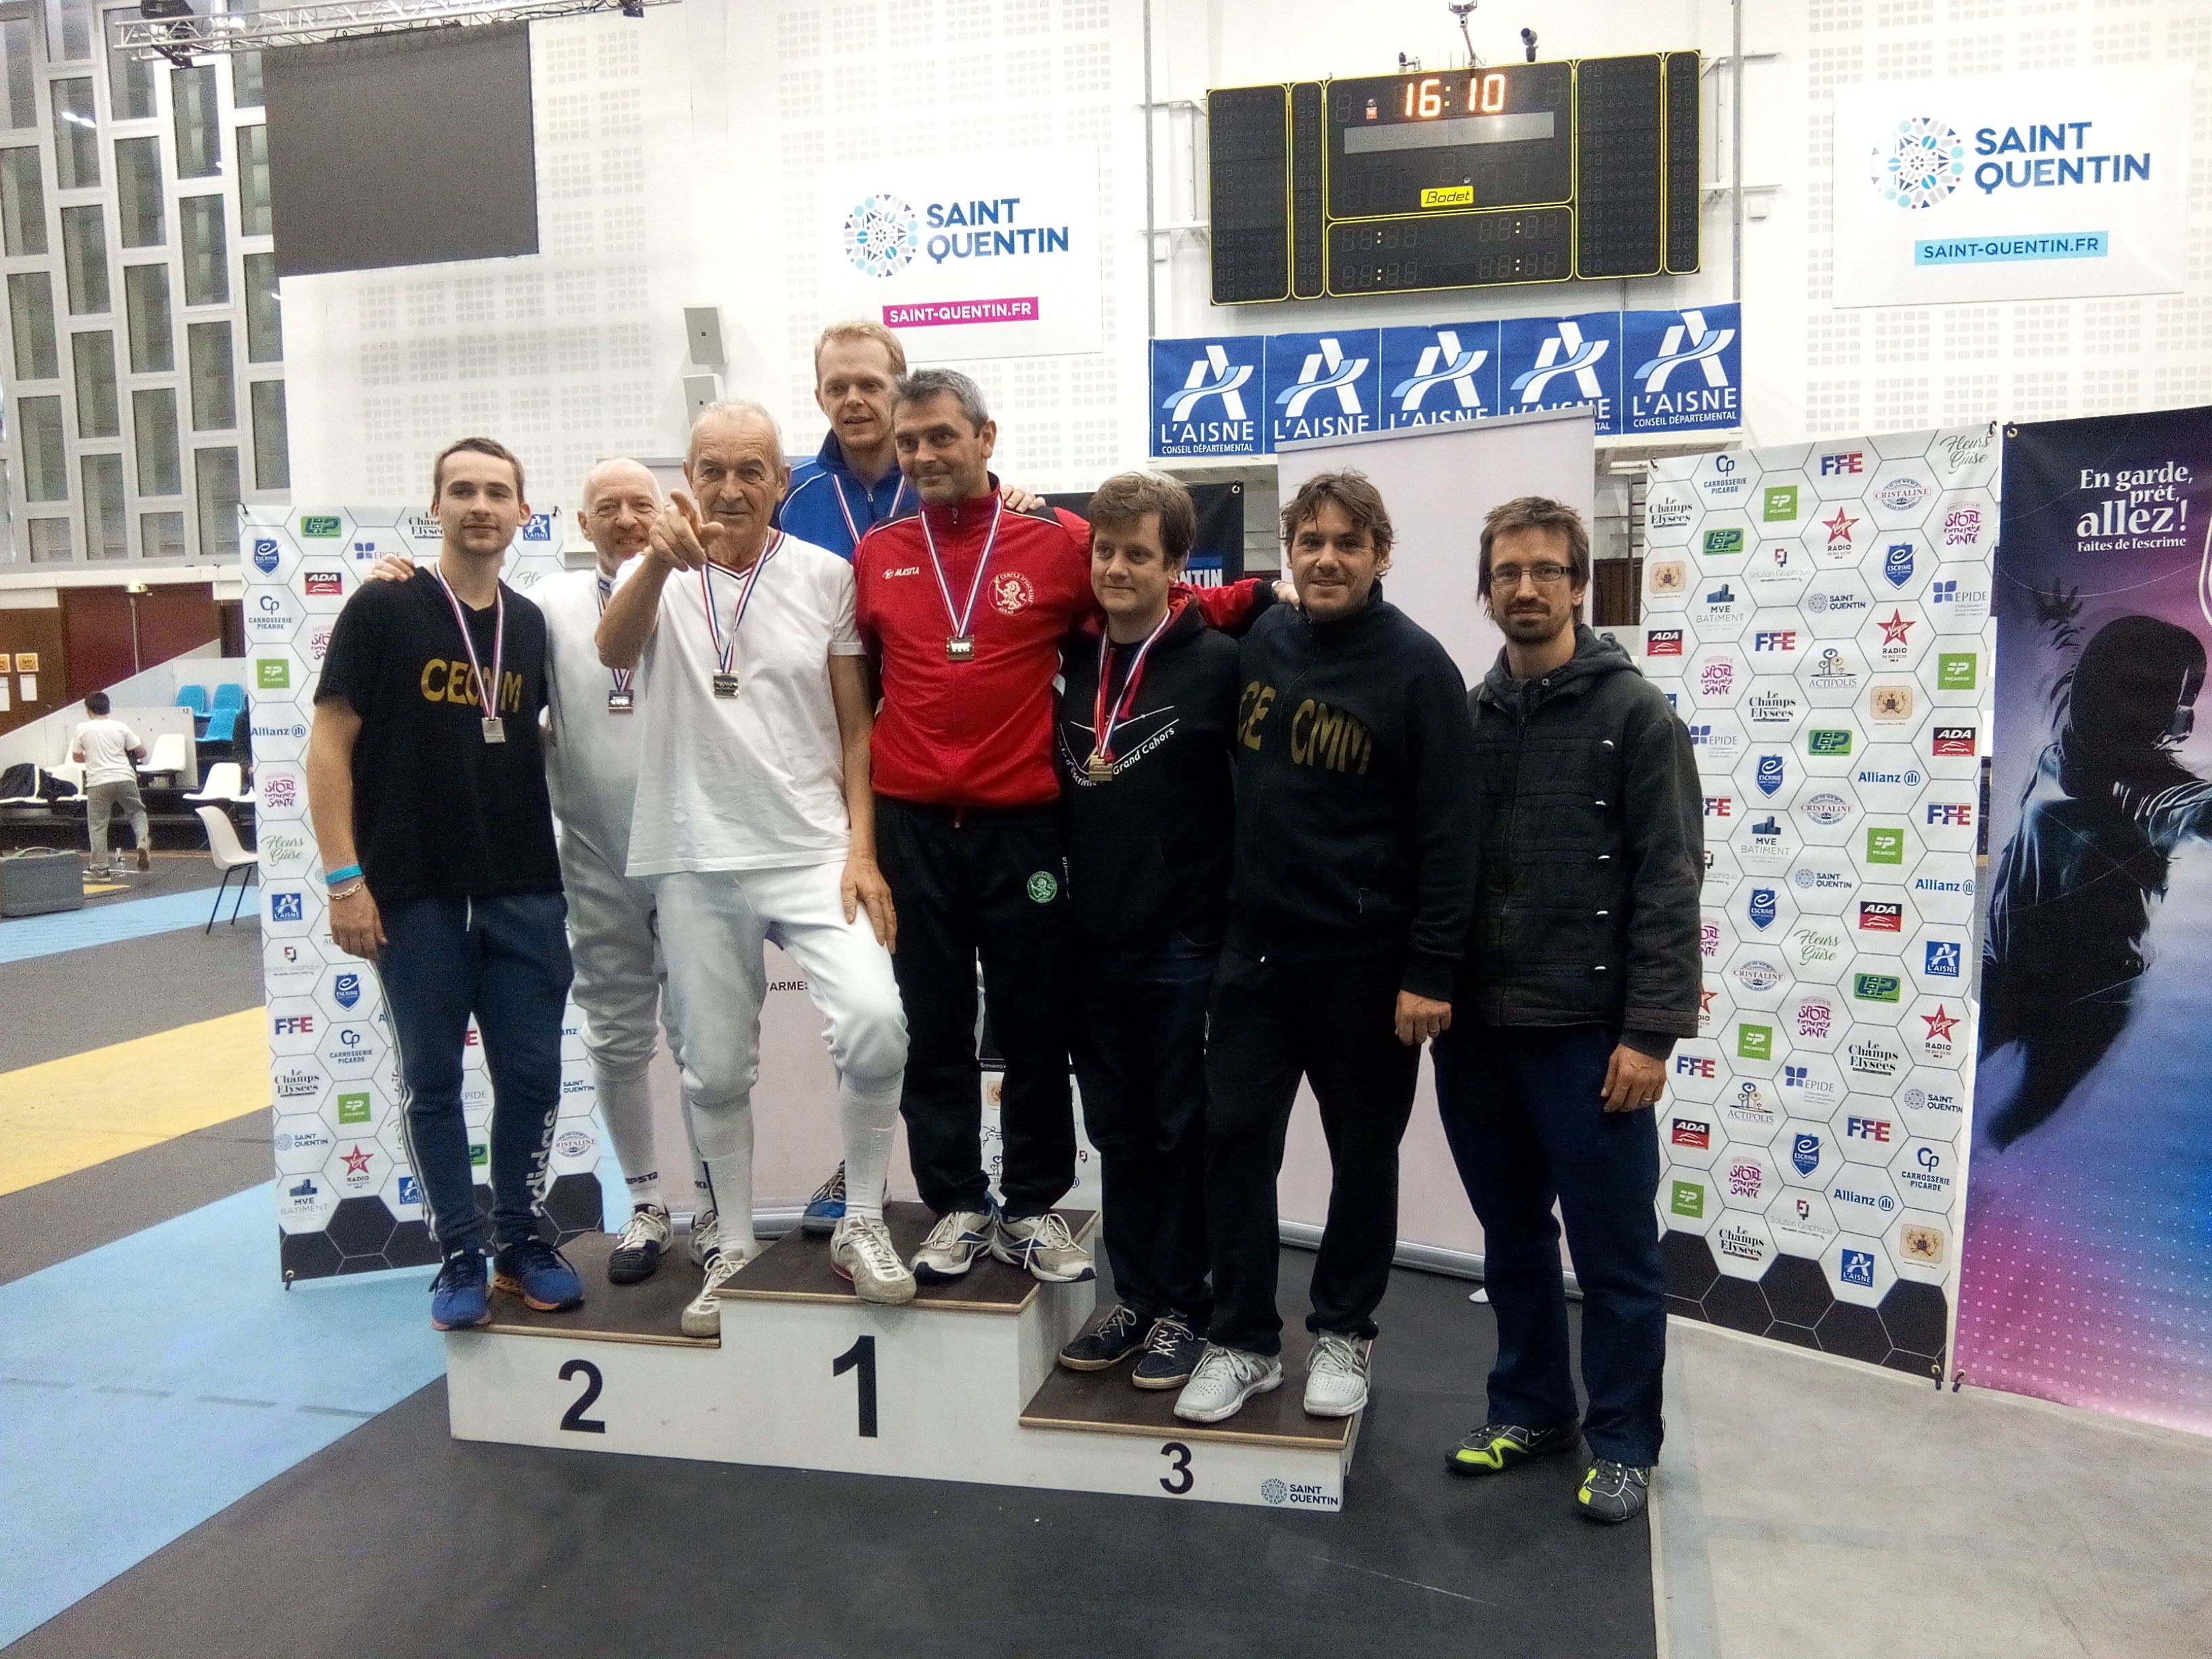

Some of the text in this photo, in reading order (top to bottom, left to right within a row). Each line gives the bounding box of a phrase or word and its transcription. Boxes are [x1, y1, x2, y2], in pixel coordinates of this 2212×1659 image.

[1974, 121, 2092, 156] SAINT
[1974, 153, 2150, 195] QUENTIN
[1425, 190, 1471, 204] Bodet
[926, 197, 1020, 229] SAINT
[926, 226, 1069, 264] QUENTIN
[1924, 239, 2098, 258] SAINT-QUENTIN.FR
[889, 303, 1031, 323] SAINT-QUENTIN.FR
[1633, 388, 1736, 416] L'AISNE
[1633, 411, 1736, 428] CONSEIL DÉPARTEMENTAL
[1162, 421, 1254, 443] L'AISNE
[1275, 415, 1370, 440] L'AISNE
[1162, 443, 1254, 454] CONSEIL DÉPARTEMENTAL
[1940, 434, 1991, 453] Fleurs
[1821, 453, 1863, 476] FFE
[2080, 461, 2193, 491] En garde,
[1704, 478, 1746, 488] CARROSSERIE
[1711, 486, 1738, 494] PICARDE
[1875, 488, 1929, 499] CRISTALINE
[1665, 497, 1677, 505] Le
[2130, 485, 2179, 508] prêt,
[1649, 503, 1693, 514] Champs
[2078, 537, 2186, 552] Faites de l'escrime
[1830, 594, 1853, 602] SAINT
[1955, 591, 1987, 602] EPIDE
[1830, 601, 1866, 610] QUENTIN
[1696, 613, 1744, 623] BATIMENT
[1652, 632, 1679, 640] ADA
[1755, 632, 1797, 651] FFE
[1809, 678, 1858, 687] ACTIPOLIS
[1767, 691, 1778, 699] Le
[1749, 696, 1796, 708] Champs
[251, 727, 289, 736] Allianz
[1938, 729, 1972, 739] ADA
[1709, 736, 1738, 745] EPIDE
[1113, 727, 1175, 775] Grand Cahors
[1858, 771, 1901, 783] Allianz
[1702, 798, 1732, 817] FE
[1927, 804, 1971, 825] FFE
[1756, 838, 1777, 846] MVE
[1741, 846, 1790, 856] BATIMENT
[1816, 872, 1841, 880] SAINT
[1816, 880, 1852, 889] QUENTIN
[1915, 879, 1960, 892] Allianz
[1864, 904, 1897, 914] ADA
[1793, 929, 1841, 947] Fleurs
[1927, 964, 1957, 973] L'AISNE
[1733, 970, 1784, 981] CRISTALINE
[275, 1017, 314, 1035] FFE
[1867, 1040, 1879, 1049] Le
[1925, 1042, 1951, 1050] RADIO
[1849, 1044, 1898, 1061] Champs
[1677, 1056, 1715, 1078] FFE
[274, 1074, 320, 1085] Champs
[1805, 1080, 1835, 1092] EPIDE
[465, 1091, 487, 1099] PIDE
[1927, 1094, 1954, 1103] SAINT
[1927, 1102, 1963, 1113] QUENTIN
[1728, 1111, 1774, 1123] ACTIPOLIS
[1676, 1122, 1705, 1132] ADA
[1847, 1118, 1891, 1142] FFE
[294, 1139, 329, 1148] QUENTIN
[556, 1139, 597, 1149] RISTALINE
[1902, 1171, 1950, 1185] CARROSSERIE
[1910, 1181, 1942, 1191] PICARDE
[294, 1197, 314, 1206] MVE
[1834, 1189, 1875, 1206] Allianz
[1737, 1226, 1748, 1234] Le
[1719, 1229, 1764, 1247] Champs
[1843, 1271, 1870, 1283] L'AISNE
[833, 1335, 878, 1438] 1
[558, 1359, 606, 1434] 2
[1160, 1442, 1194, 1495] 3
[1290, 1484, 1322, 1494] SAINT
[1290, 1494, 1338, 1505] QUENTIN
